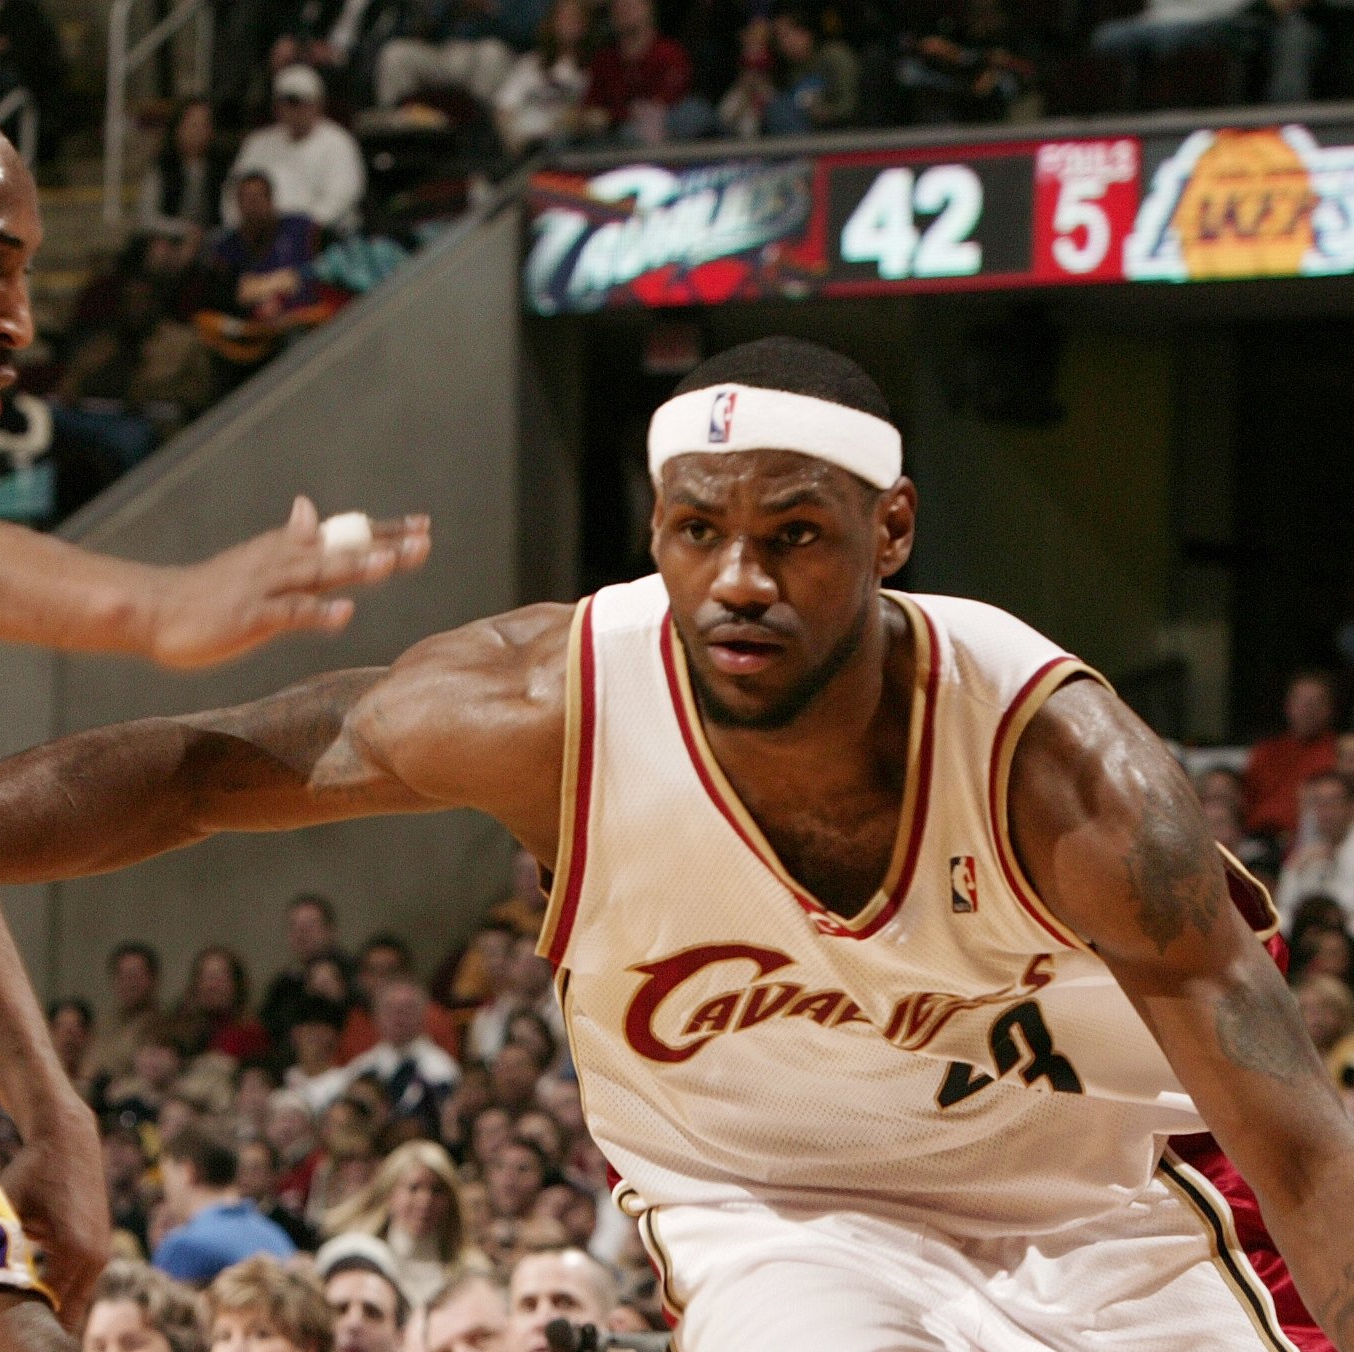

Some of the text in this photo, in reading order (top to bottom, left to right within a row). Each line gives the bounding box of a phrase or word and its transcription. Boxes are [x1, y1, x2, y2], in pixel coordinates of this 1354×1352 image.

[843, 164, 983, 278] 42
[1051, 179, 1112, 275] 5
[624, 942, 1056, 1064] CAVALIS
